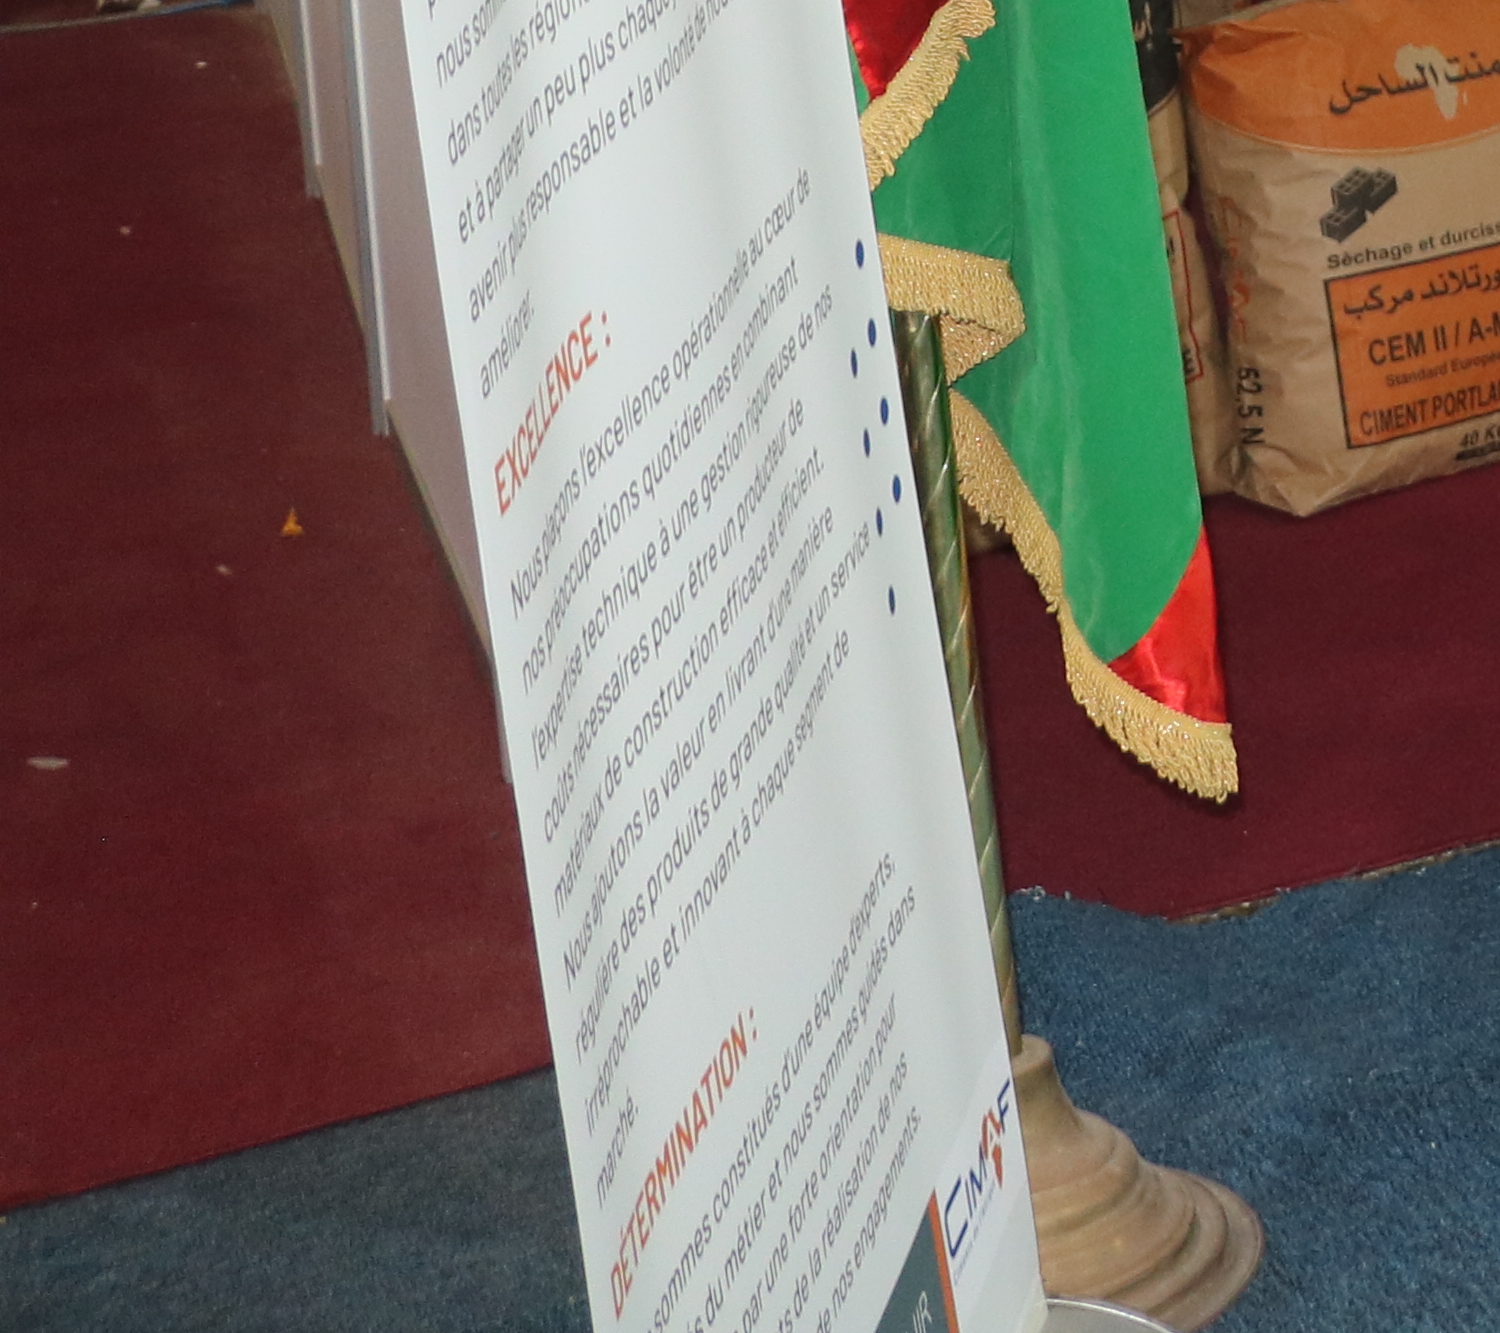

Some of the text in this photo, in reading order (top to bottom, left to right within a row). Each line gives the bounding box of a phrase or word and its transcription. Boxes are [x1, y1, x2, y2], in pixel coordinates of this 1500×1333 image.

[1328, 62, 1439, 115] الساحل
[1418, 234, 1435, 252] et
[1343, 284, 1415, 320] مركب
[1368, 333, 1426, 366] CEM
[1359, 398, 1429, 437] CIMENT
